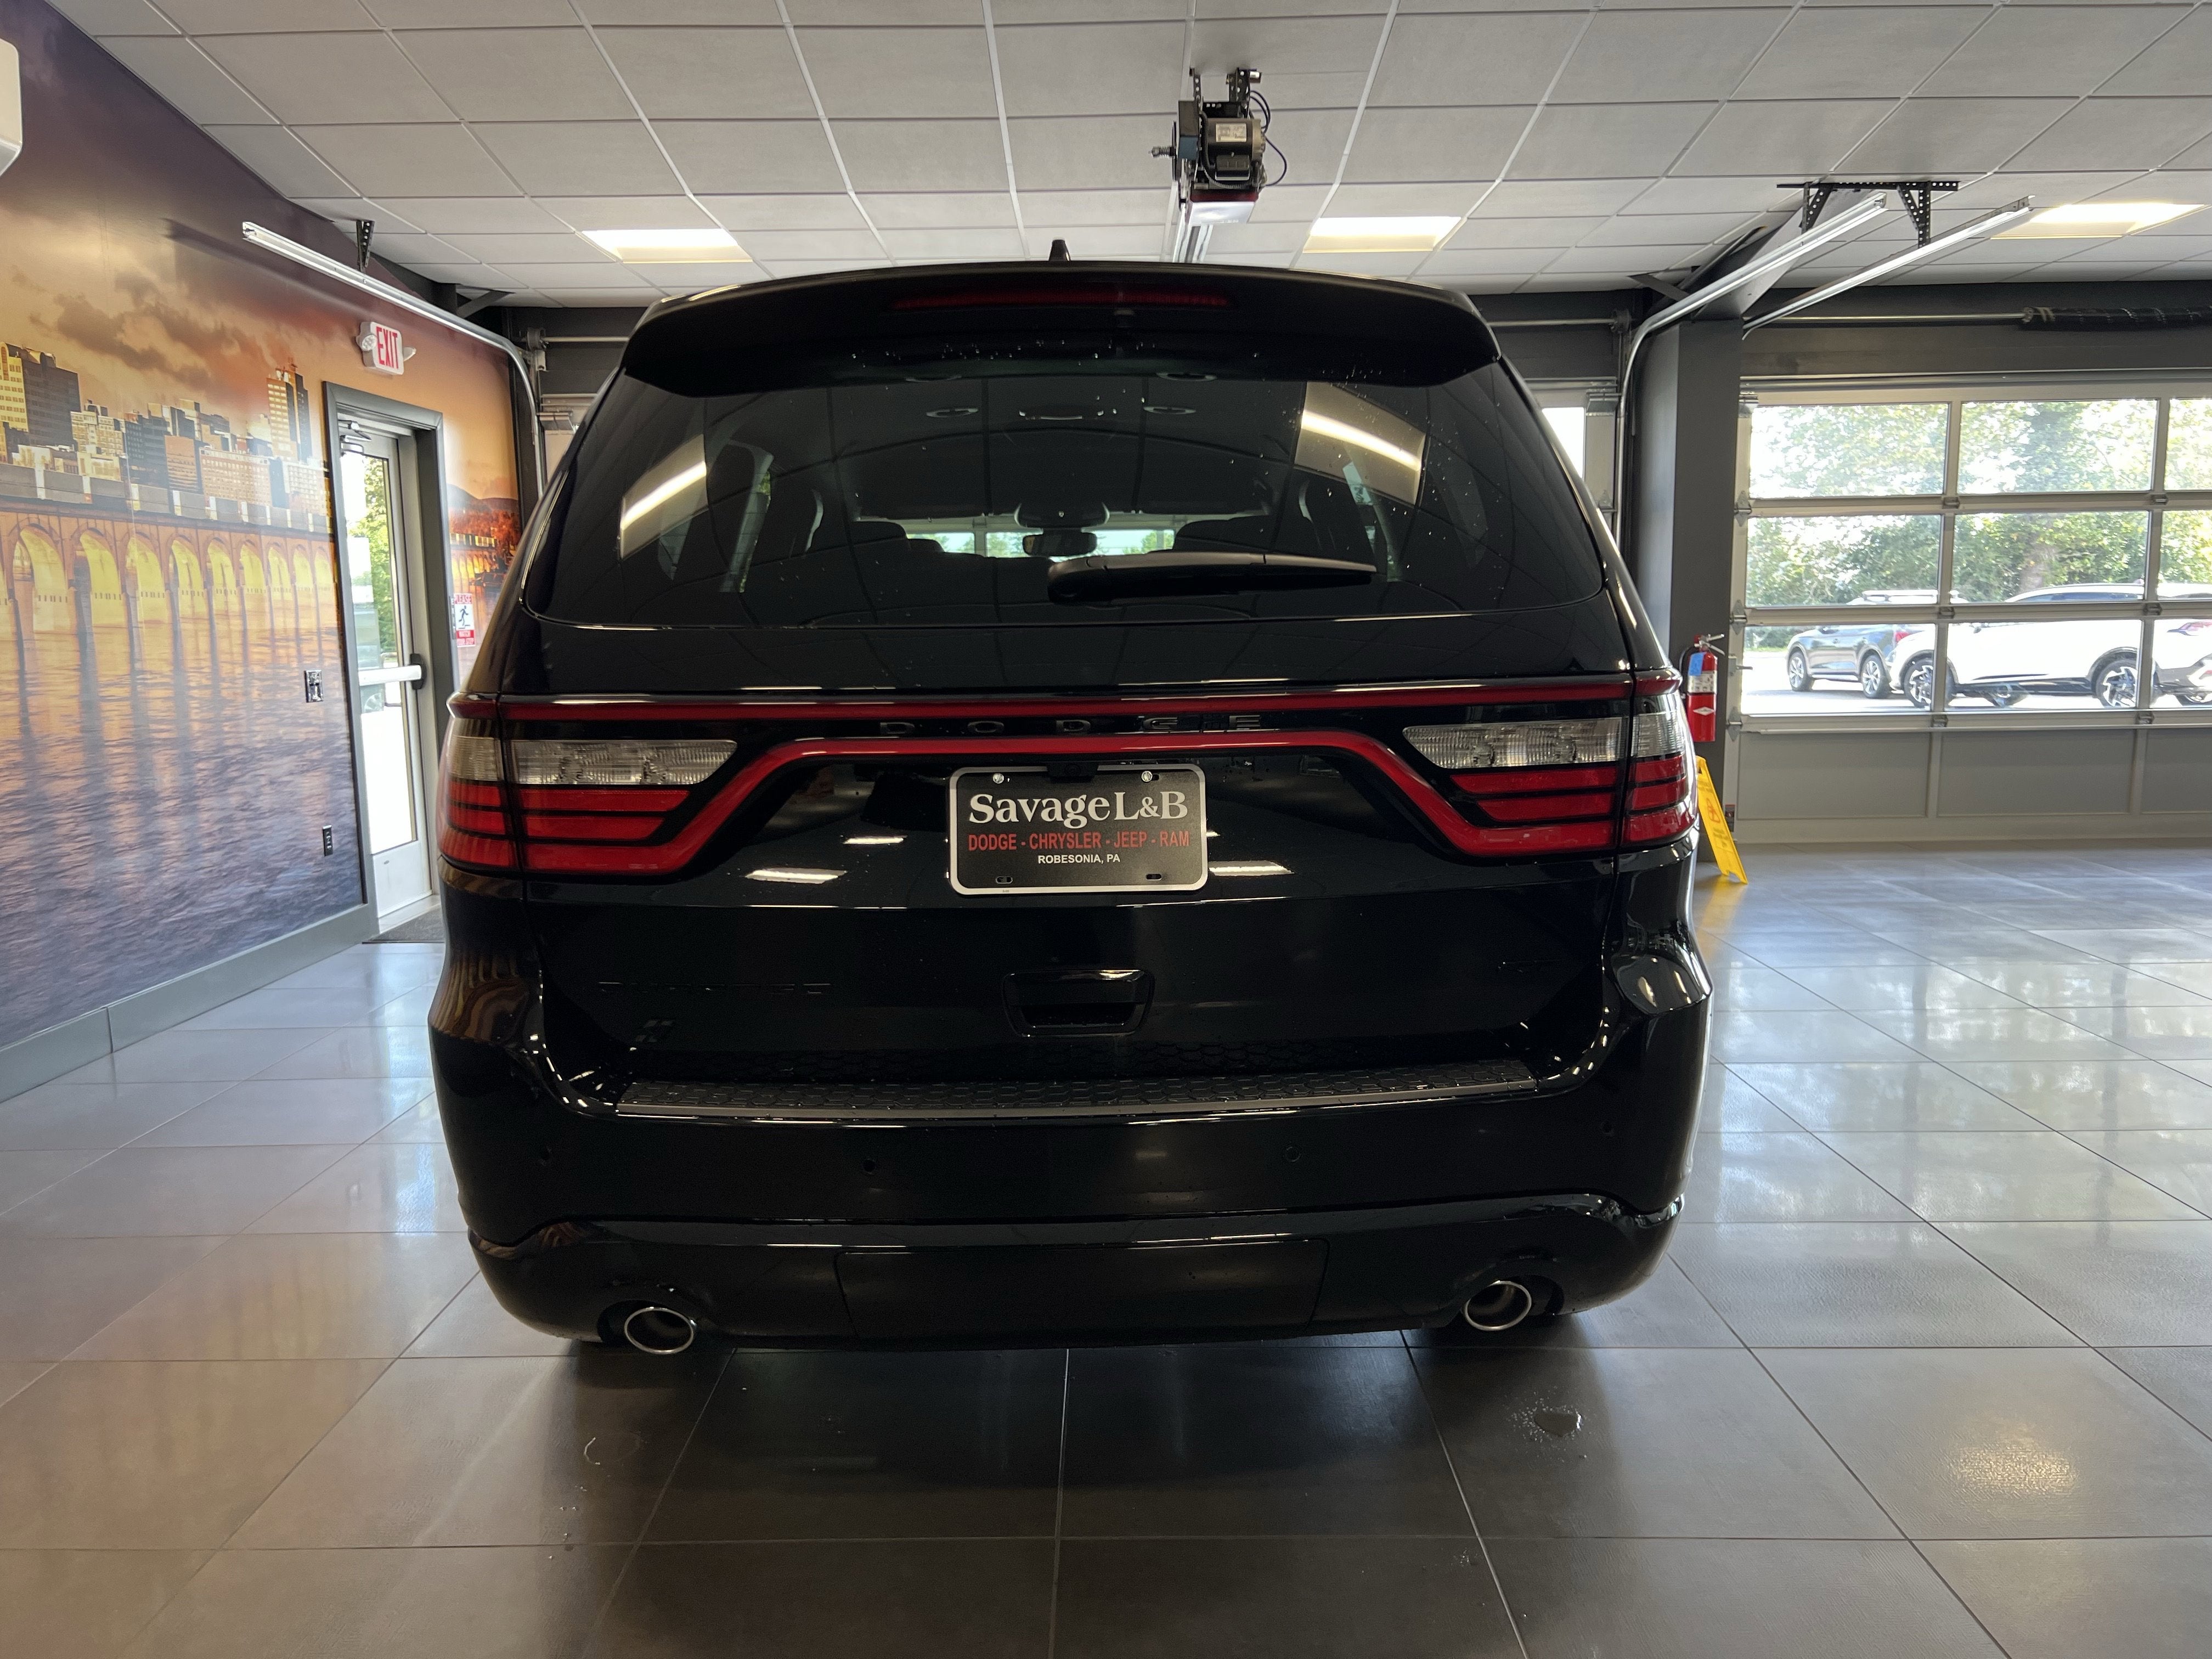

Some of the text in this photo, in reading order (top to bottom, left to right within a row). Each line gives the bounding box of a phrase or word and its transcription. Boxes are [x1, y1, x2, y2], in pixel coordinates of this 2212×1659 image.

[376, 326, 398, 369] EXIT
[879, 714, 1261, 735] DODGE
[968, 833, 1017, 851] DODGE
[1029, 832, 1102, 849] CHRYSLER
[1114, 831, 1147, 848] JEEP
[1160, 831, 1190, 847] RAM
[1038, 854, 1121, 865] ROBESONIA, PA
